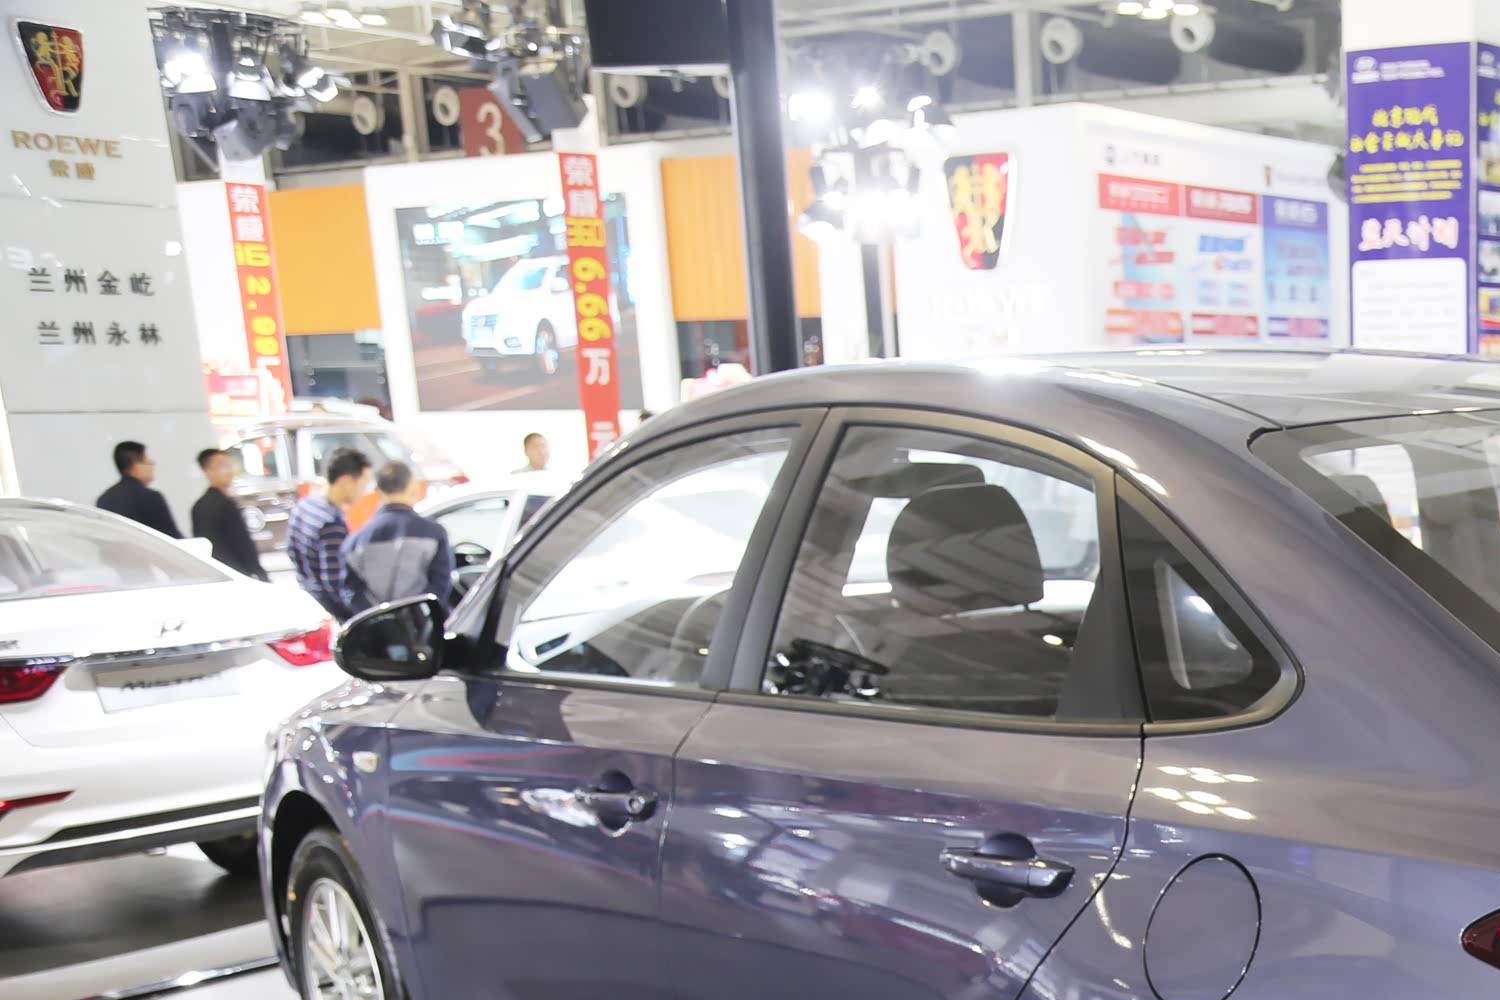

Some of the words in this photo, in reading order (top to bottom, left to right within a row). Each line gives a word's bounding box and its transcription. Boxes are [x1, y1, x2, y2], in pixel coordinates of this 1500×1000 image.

[11, 129, 124, 159] ROEWE
[476, 102, 505, 157] 3
[37, 320, 163, 347] 兰州永林
